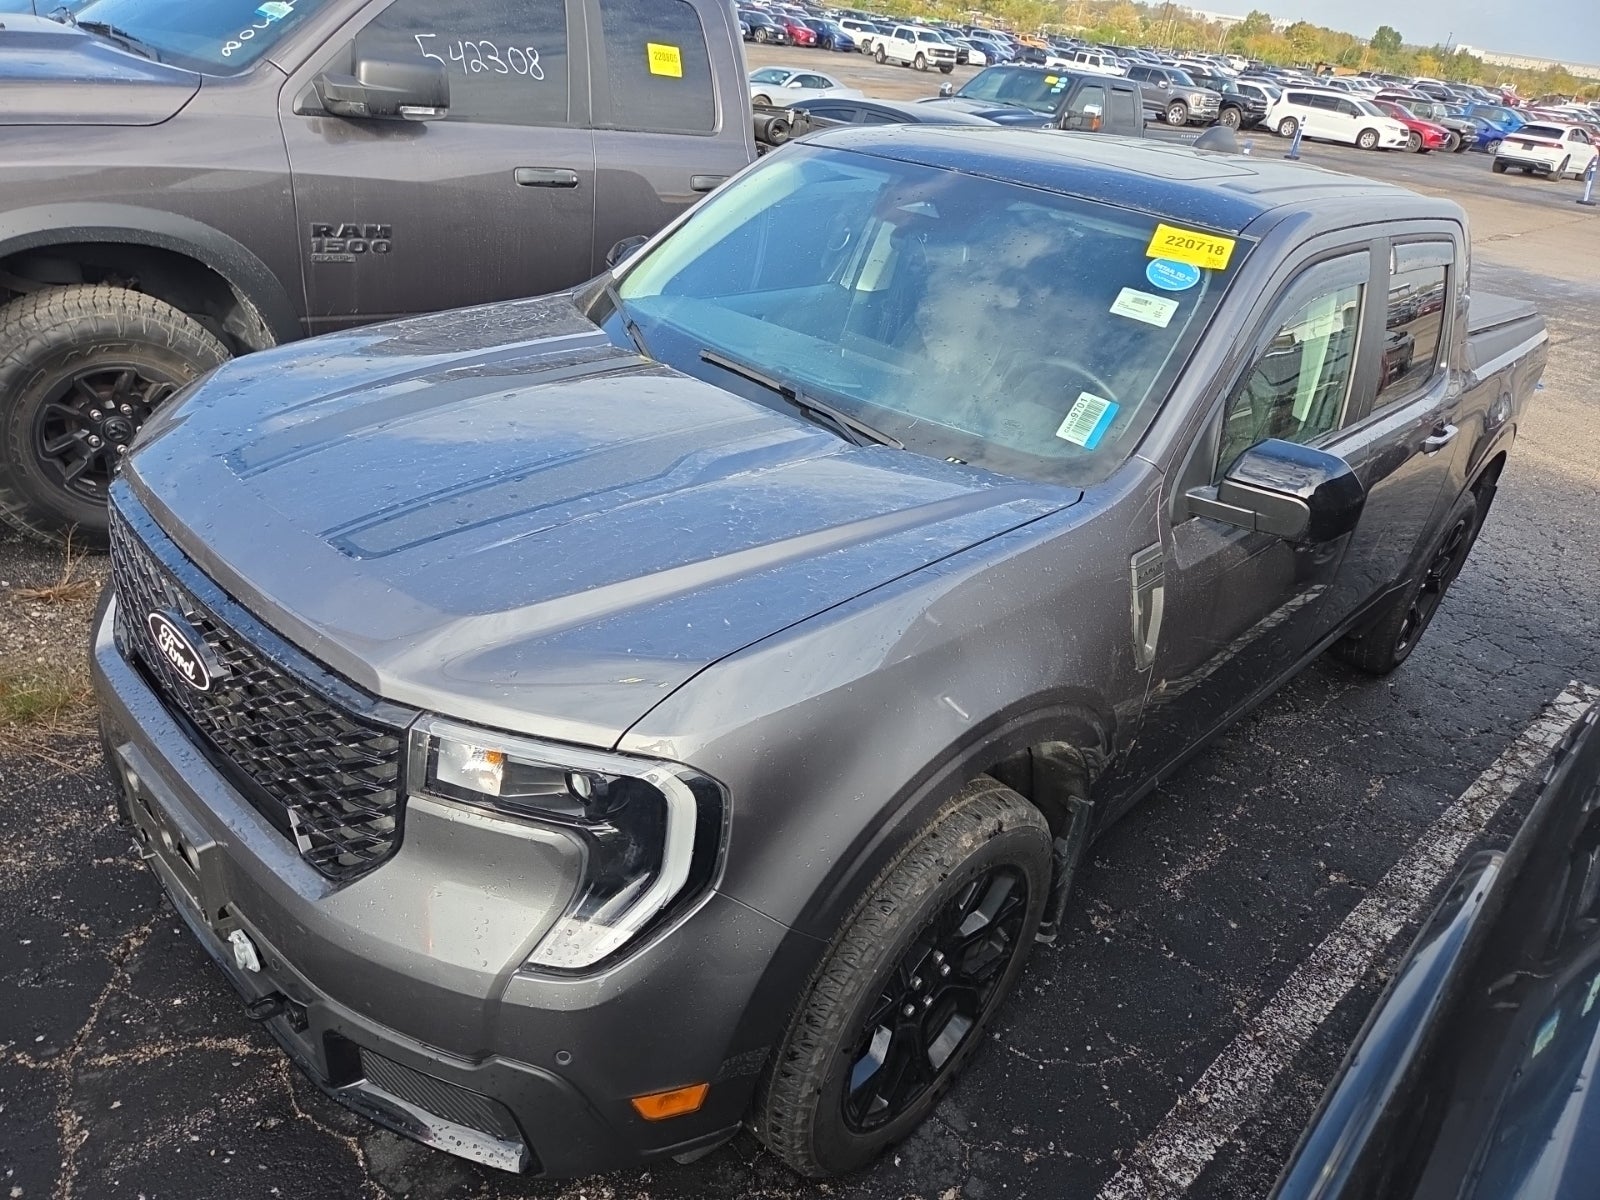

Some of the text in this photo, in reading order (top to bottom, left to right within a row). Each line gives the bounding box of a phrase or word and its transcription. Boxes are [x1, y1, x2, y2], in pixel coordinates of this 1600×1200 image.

[415, 33, 544, 80] 542308
[311, 223, 391, 238] RAM
[311, 238, 391, 254] 1500
[1165, 235, 1225, 256] 220718
[159, 623, 195, 680] Ford
